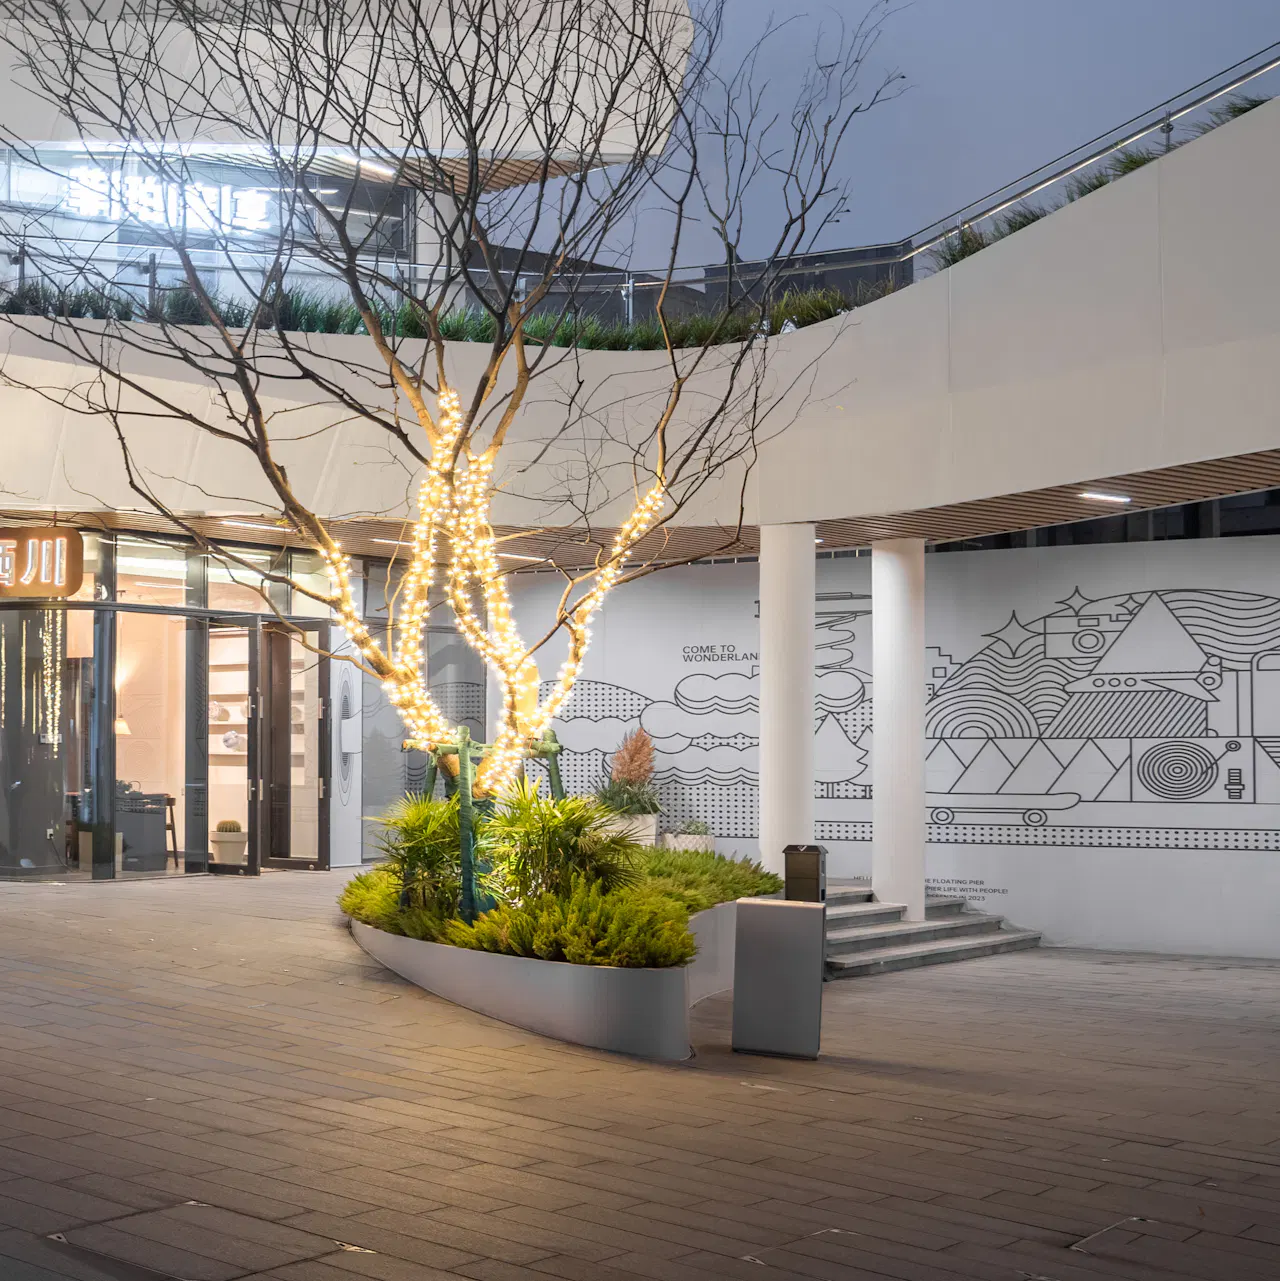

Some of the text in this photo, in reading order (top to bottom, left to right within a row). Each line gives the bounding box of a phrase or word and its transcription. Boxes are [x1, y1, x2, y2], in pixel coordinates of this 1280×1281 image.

[682, 644, 736, 654] COME TO
[682, 653, 760, 662] WONDERLAN
